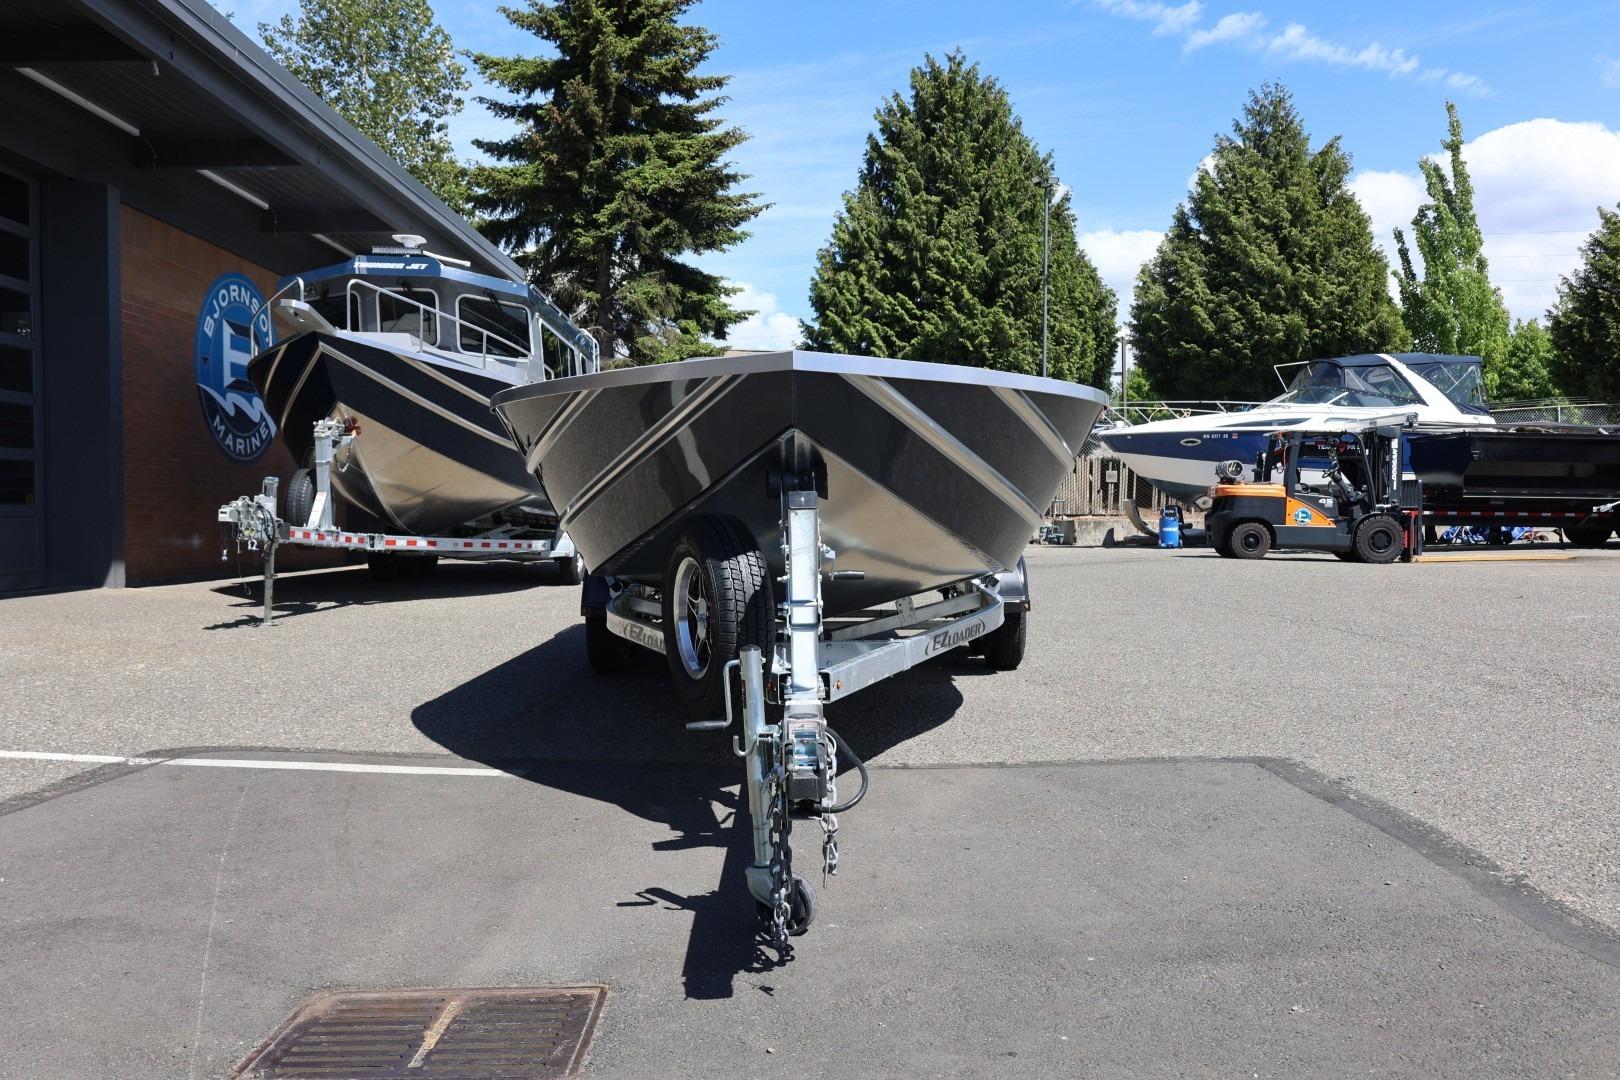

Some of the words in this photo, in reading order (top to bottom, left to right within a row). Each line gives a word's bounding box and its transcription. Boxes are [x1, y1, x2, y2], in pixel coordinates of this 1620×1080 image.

[203, 285, 269, 342] BJORNSO
[213, 414, 269, 455] MARINE
[1319, 498, 1333, 508] 45
